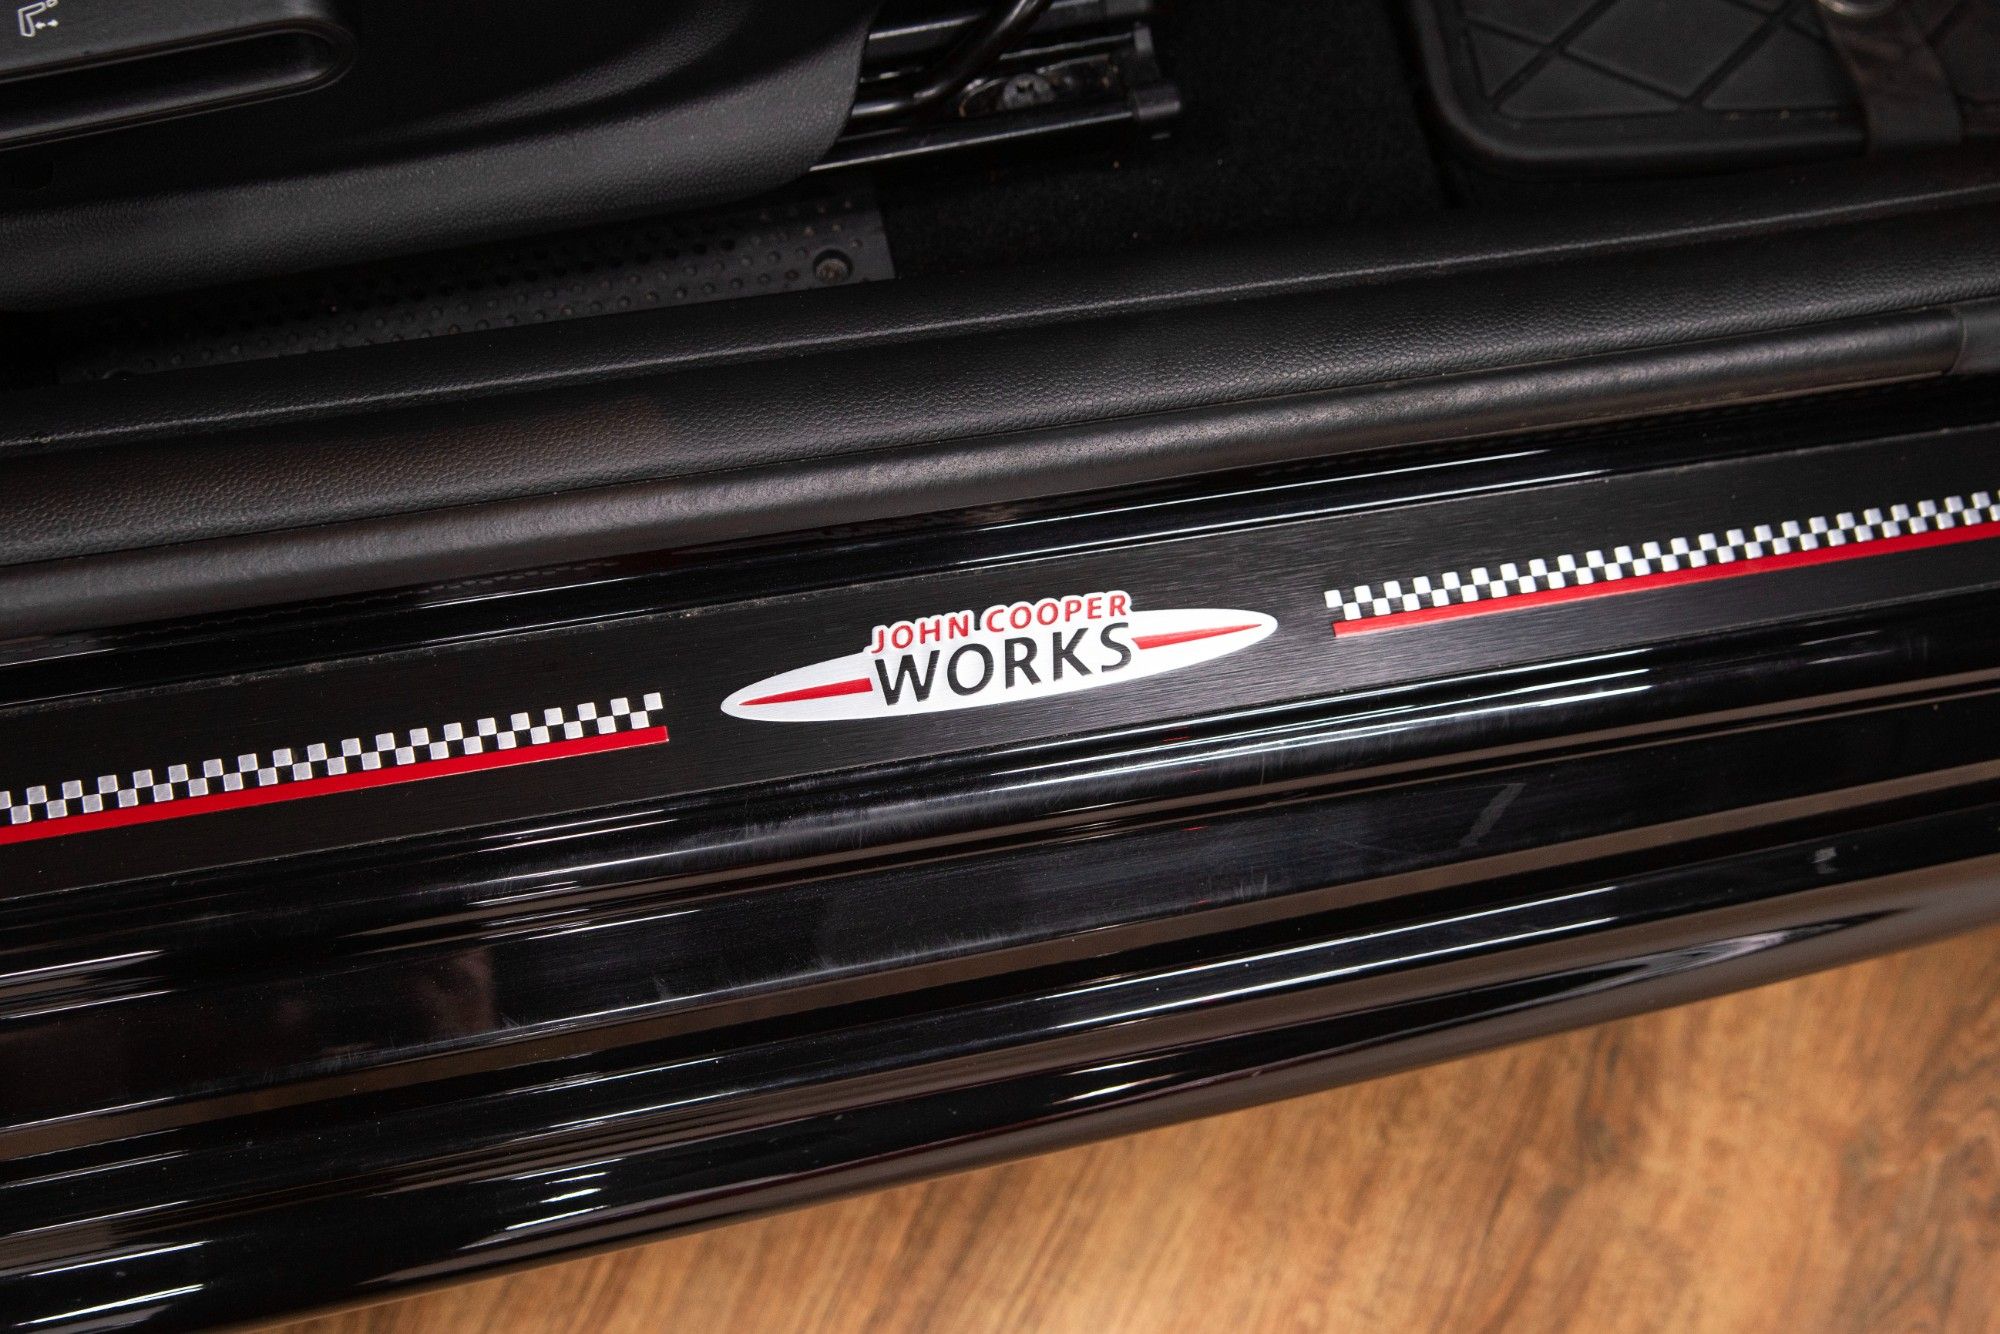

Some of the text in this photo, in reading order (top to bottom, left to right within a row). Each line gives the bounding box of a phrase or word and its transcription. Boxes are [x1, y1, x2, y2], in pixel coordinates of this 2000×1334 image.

[871, 595, 1126, 654] JOHN COOPER
[875, 622, 1132, 706] WORKS
